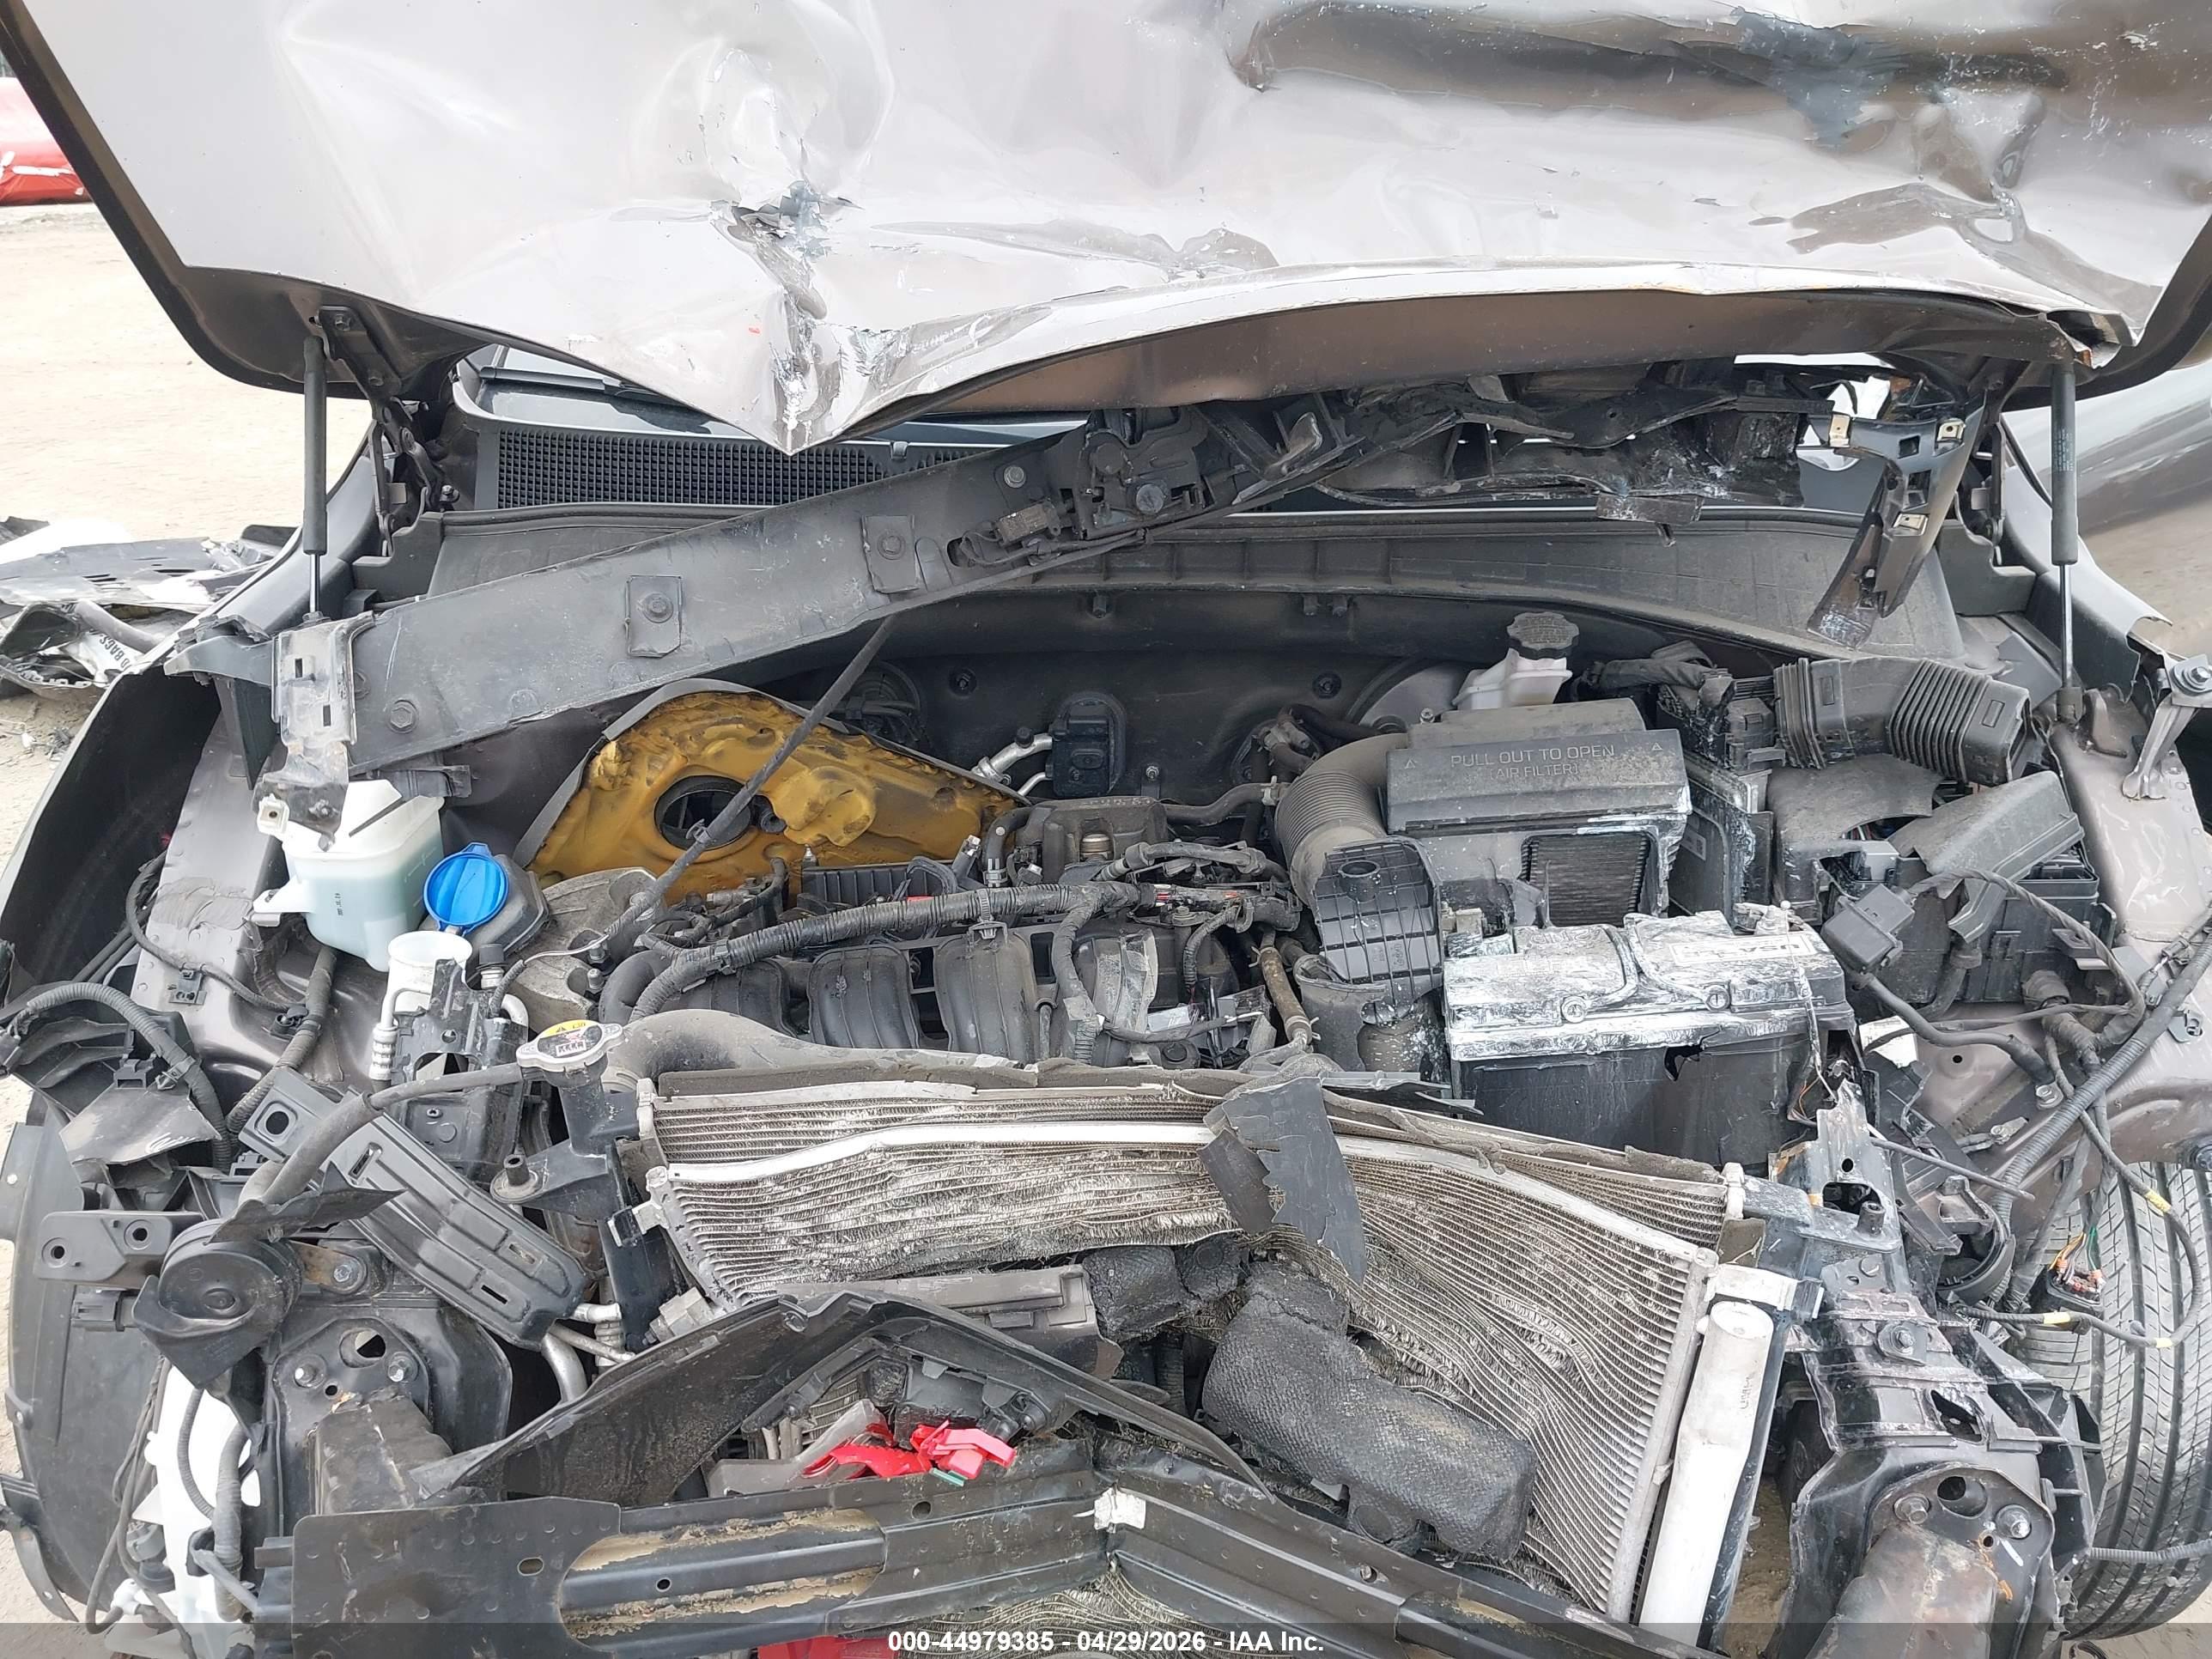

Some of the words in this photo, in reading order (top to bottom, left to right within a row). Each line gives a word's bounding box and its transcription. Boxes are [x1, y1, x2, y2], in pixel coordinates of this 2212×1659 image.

[100, 635, 125, 661] BAGS
[1451, 752, 1495, 768] PULL
[1499, 750, 1534, 763] OUT
[1539, 748, 1561, 761] TO
[1567, 744, 1615, 759] OPEN
[1524, 763, 1578, 777] FILTER)
